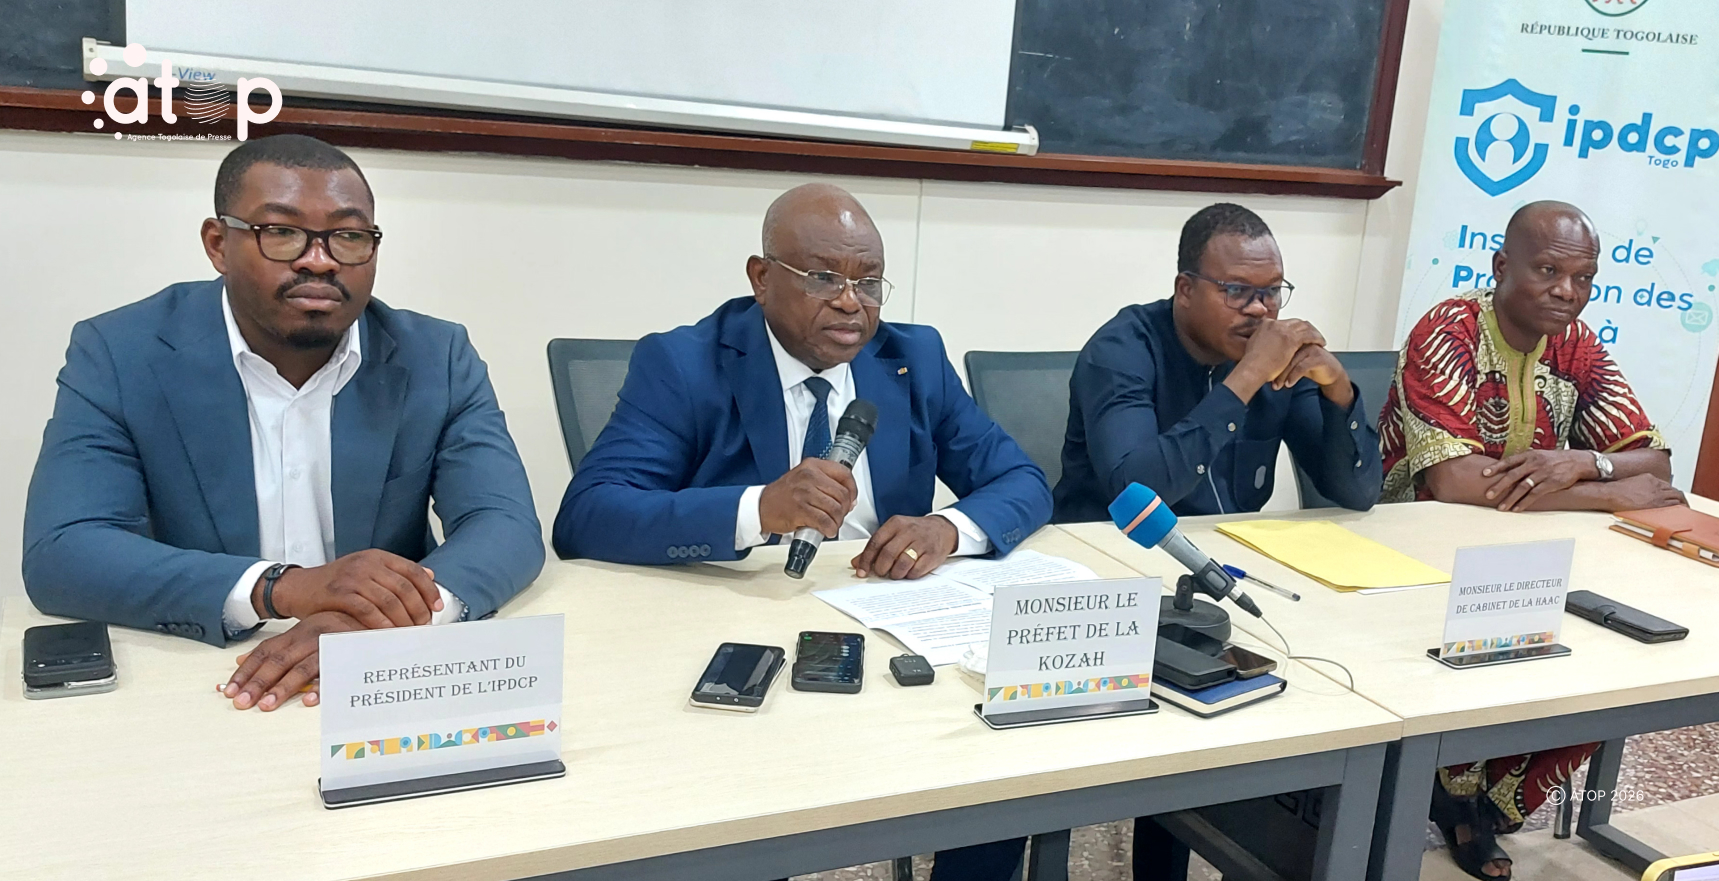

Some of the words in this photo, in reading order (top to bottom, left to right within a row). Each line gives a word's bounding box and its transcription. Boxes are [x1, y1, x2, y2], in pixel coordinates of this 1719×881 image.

[1520, 21, 1609, 41] RÉPUBLIQUE
[1613, 28, 1699, 46] TOGOLAISE
[171, 66, 216, 81] -View
[1562, 104, 1719, 168] ipdcp
[1647, 155, 1679, 169] Togo
[1611, 238, 1654, 266] de
[1633, 282, 1694, 311] des
[1598, 318, 1619, 344] à
[1458, 583, 1501, 596] MONSIEUR
[1503, 582, 1515, 592] LE
[1516, 578, 1563, 591] DIRECTEUR
[1014, 594, 1110, 616] MONSIEUR
[1115, 592, 1138, 608] LE
[1456, 604, 1468, 614] DE
[1469, 600, 1507, 613] CABINET
[1508, 599, 1520, 609] DE
[1521, 598, 1533, 607] LA
[1535, 596, 1560, 606] HAAC
[1006, 623, 1081, 645] PRÉFET
[1085, 622, 1109, 639] DE
[1114, 620, 1140, 637] LA
[363, 658, 500, 684] REPRÉSENTANT
[505, 655, 527, 669] DU
[1038, 651, 1105, 671] KOZAH
[350, 685, 446, 708] PRÉSIDENT
[451, 682, 473, 697] DE
